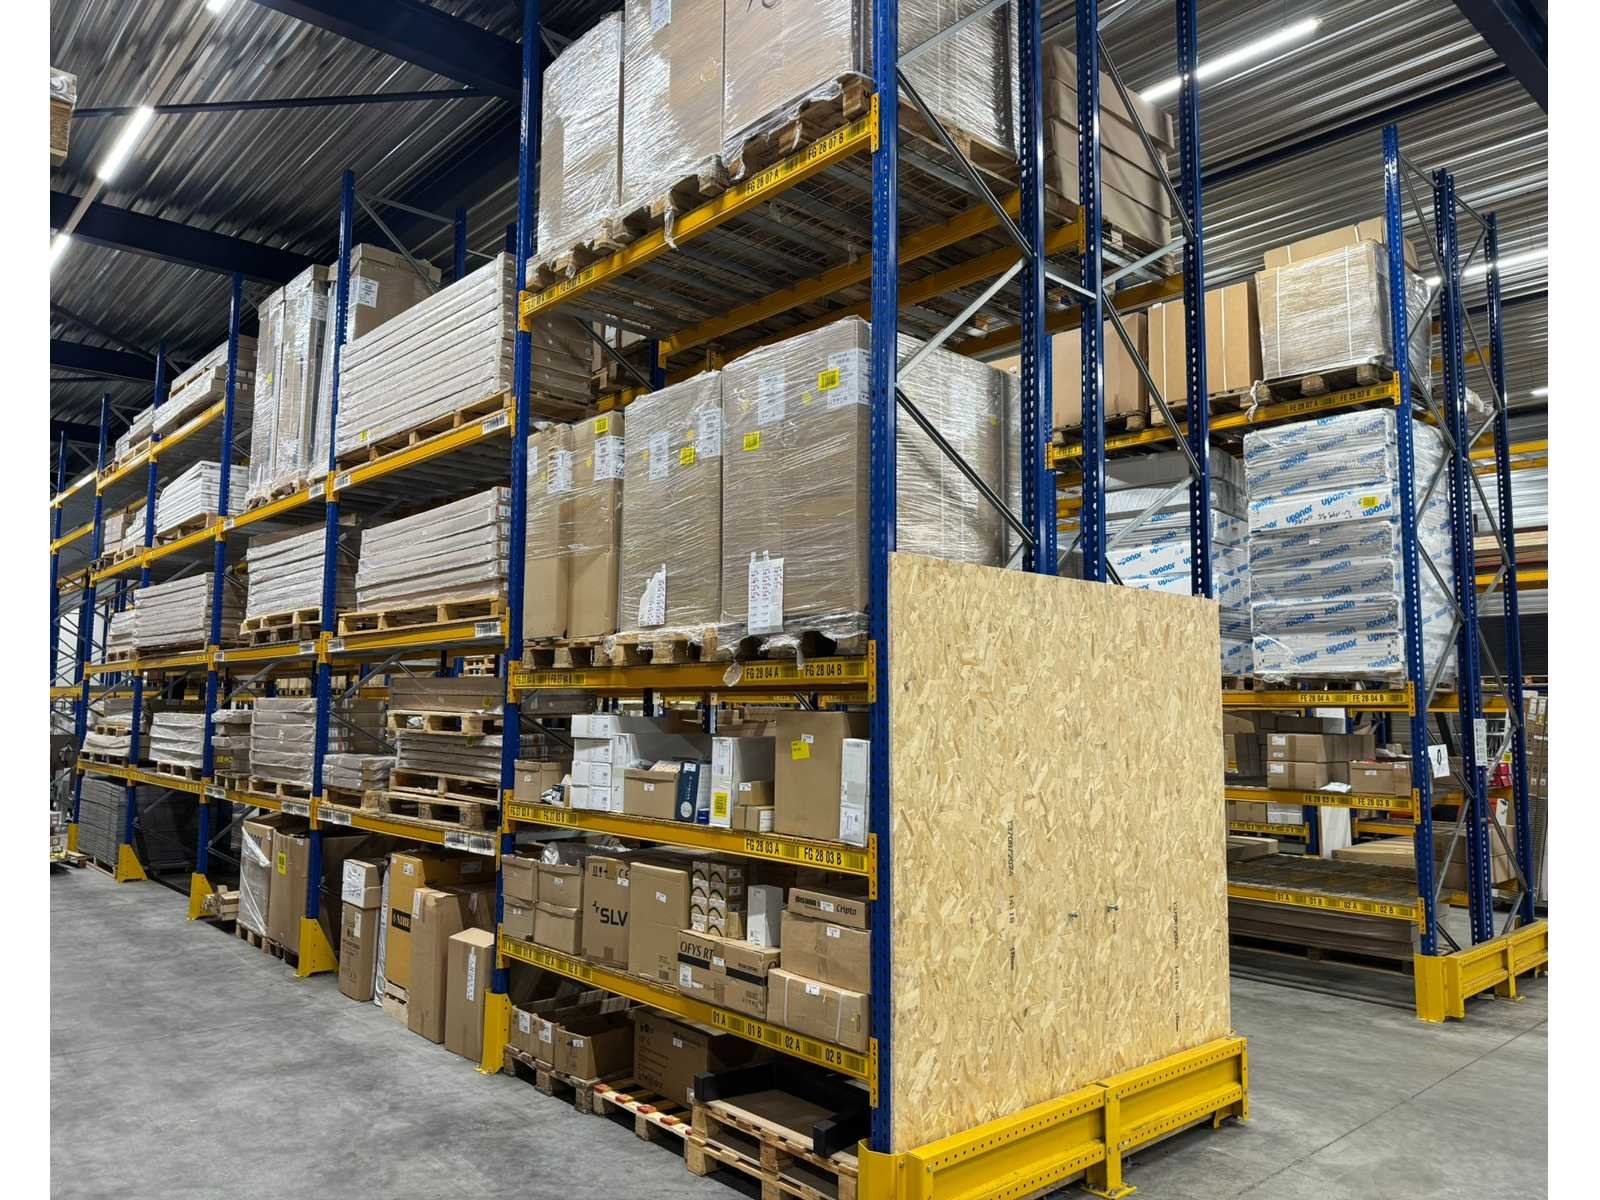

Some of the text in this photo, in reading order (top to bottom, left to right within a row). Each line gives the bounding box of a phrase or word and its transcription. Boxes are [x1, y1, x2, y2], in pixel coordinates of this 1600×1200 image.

[808, 148, 817, 160] FG
[828, 137, 837, 149] 07
[1286, 504, 1313, 523] uponor
[1150, 562, 1175, 576] uponor
[1326, 639, 1357, 655] uponor
[746, 668, 754, 679] FG
[774, 667, 779, 677] A
[805, 664, 842, 677] FG 28 04 B
[1300, 694, 1307, 702] FE
[1358, 798, 1365, 806] FE
[746, 838, 779, 854] FG 28 03 A
[804, 847, 842, 865] FG 28 03 B
[1344, 901, 1358, 910] 02 A
[1379, 905, 1388, 913] 02
[600, 908, 628, 927] SLV
[680, 941, 701, 957] OFYS
[713, 1010, 726, 1026] 01 A
[747, 1023, 762, 1039] 01 B
[785, 1035, 800, 1052] 02 A
[825, 1048, 842, 1065] 02 B
